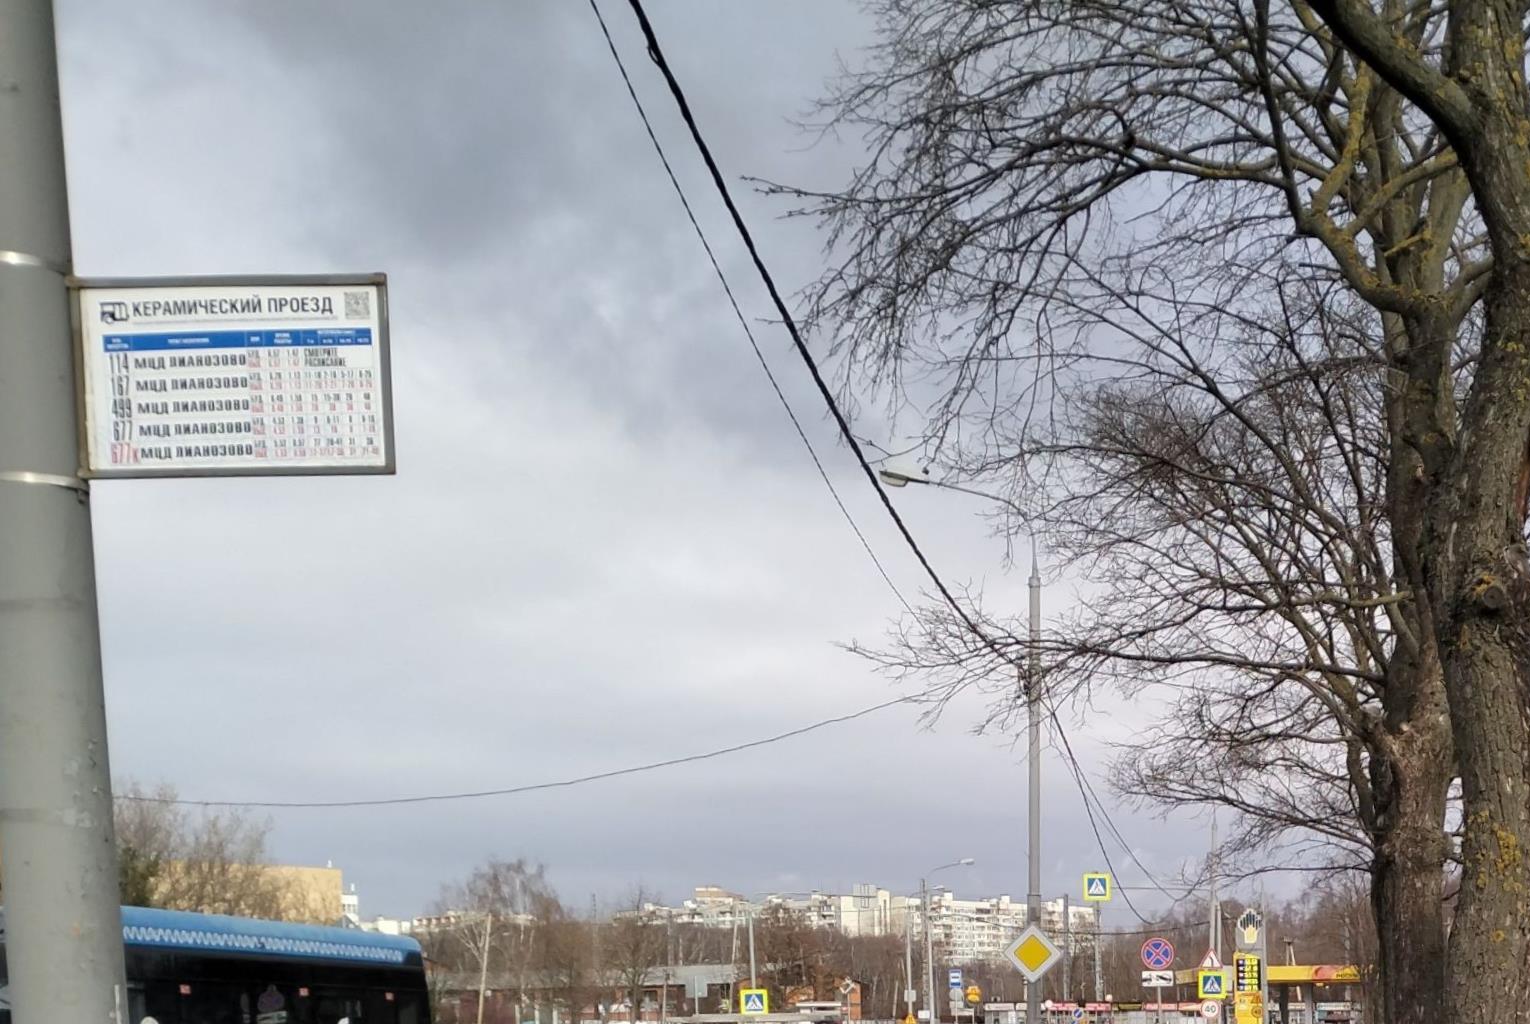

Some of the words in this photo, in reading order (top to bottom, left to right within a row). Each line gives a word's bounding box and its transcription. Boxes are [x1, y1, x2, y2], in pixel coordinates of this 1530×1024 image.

[132, 294, 263, 317] КЕРАМИЧЕСКИЙ
[268, 296, 334, 313] ПРОЕЗД
[109, 353, 129, 374] 114
[134, 357, 166, 370] МЦД
[169, 354, 247, 368] ЛИАНОЗОВО
[111, 375, 130, 396] 167
[136, 379, 167, 392] МЦД
[171, 377, 248, 390] ЛИАНОЗОВО
[112, 398, 132, 418] 499
[138, 402, 169, 415] МЦД
[172, 399, 250, 413] ЛИАНОЗОВО
[113, 420, 132, 441] 677
[139, 424, 170, 437] МЦД
[174, 421, 251, 435] ЛИАНОЗОВО
[141, 446, 172, 460] МЦД
[175, 444, 253, 458] ЛИАНОЗОВО
[1204, 1004, 1217, 1013] 40
